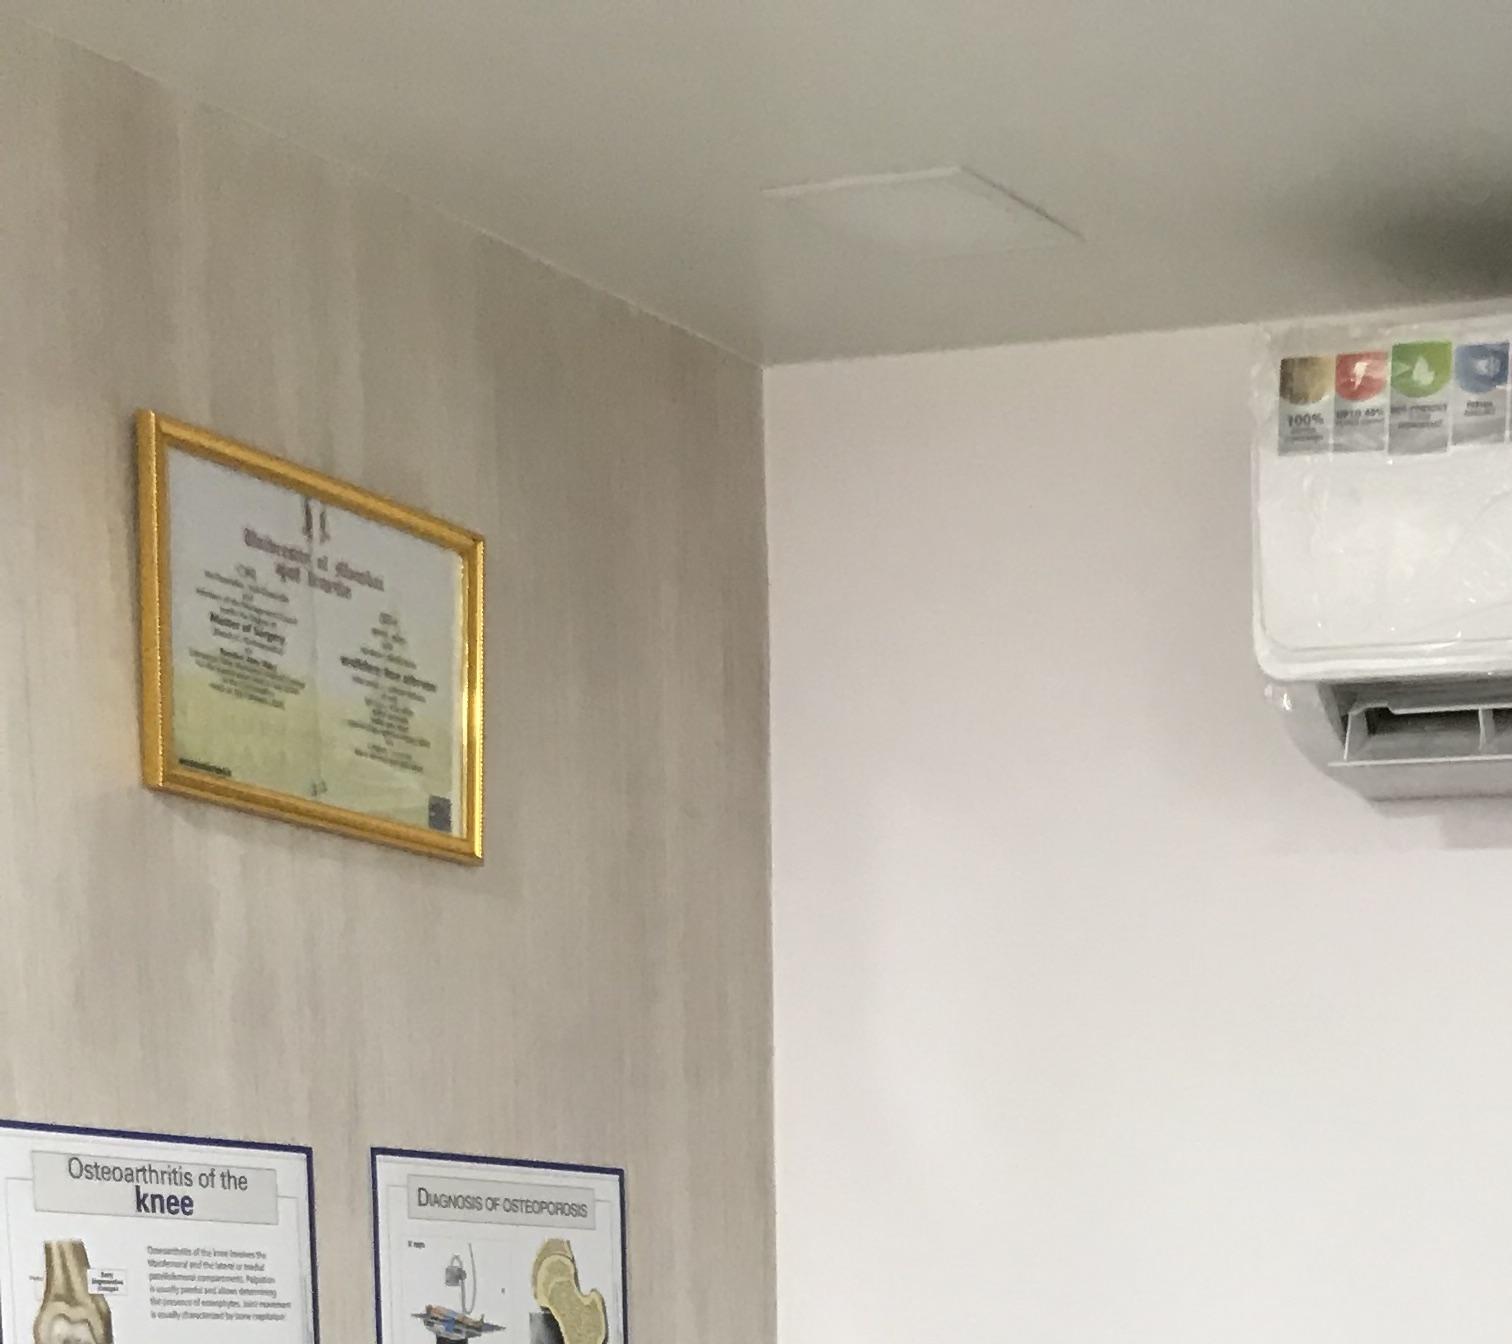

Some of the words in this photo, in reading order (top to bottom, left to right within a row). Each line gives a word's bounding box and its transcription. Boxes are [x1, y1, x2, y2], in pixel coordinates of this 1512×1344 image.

[68, 1157, 193, 1187] Osteoarthritis
[199, 1169, 218, 1188] of
[220, 1172, 248, 1191] the
[135, 1186, 194, 1215] knee
[417, 1187, 482, 1211] DIAGNOSIS
[485, 1198, 500, 1212] OF
[503, 1199, 588, 1218] OSTEOPOROSIS
